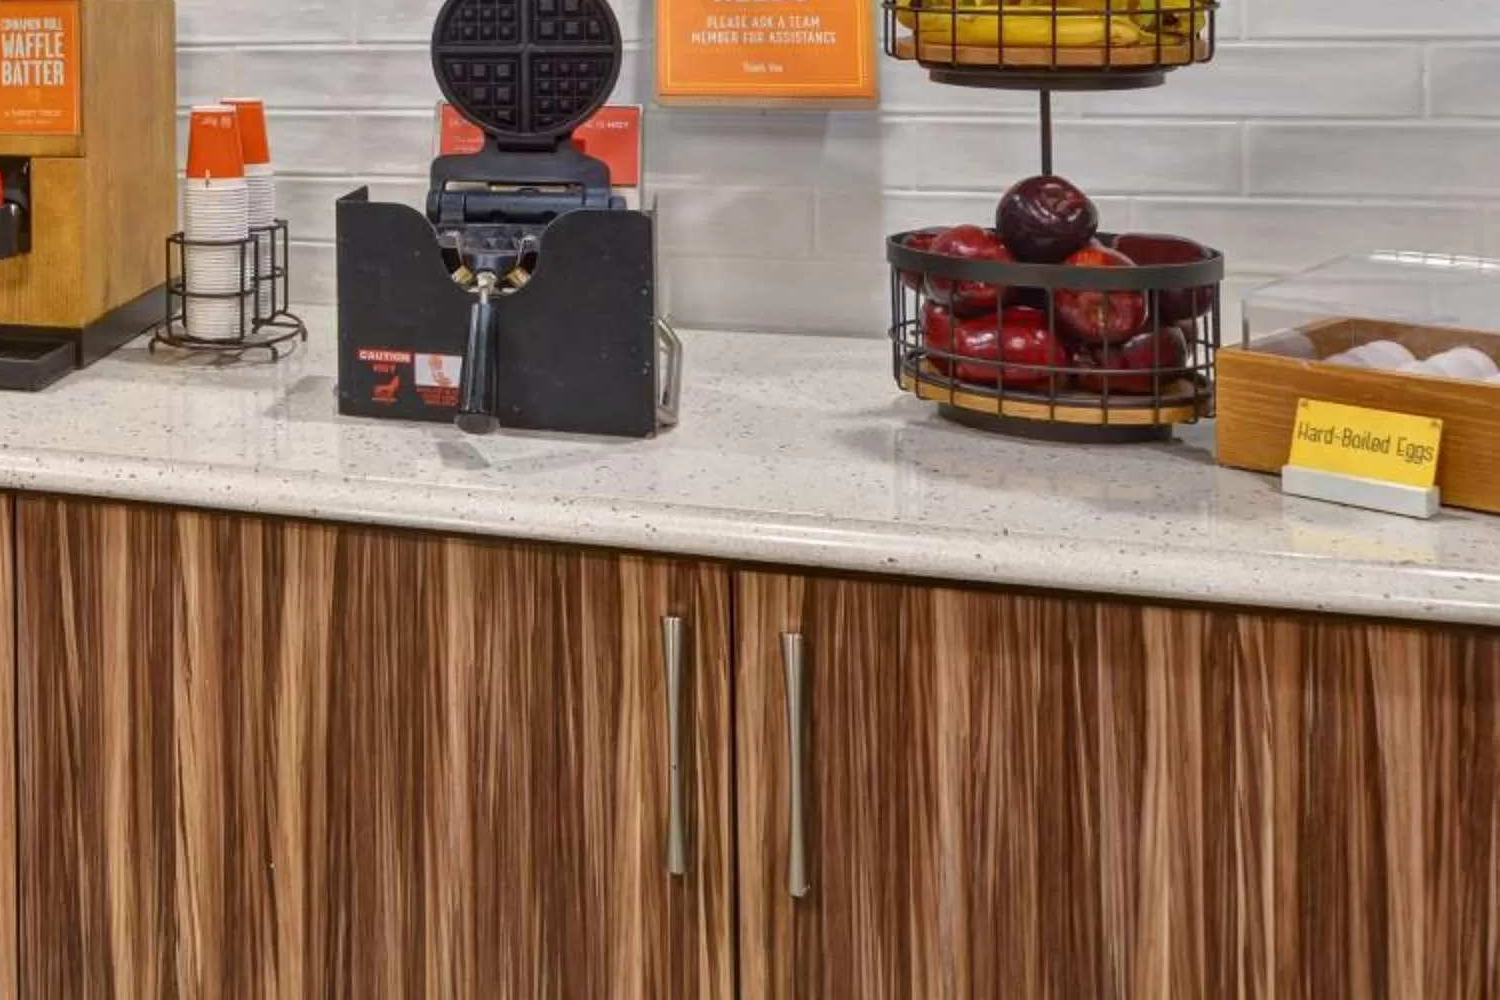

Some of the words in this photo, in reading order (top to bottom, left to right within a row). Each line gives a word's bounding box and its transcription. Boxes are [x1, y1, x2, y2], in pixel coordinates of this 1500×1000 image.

[707, 15, 748, 29] PLEASE
[751, 15, 773, 28] ASK
[777, 15, 785, 28] A
[789, 15, 820, 28] TEAM
[2, 31, 65, 59] WAFFLE
[691, 31, 738, 44] MEMBER
[743, 31, 764, 44] FOR
[768, 31, 837, 45] ASSISTANCE
[1, 59, 65, 87] BATTER
[359, 350, 411, 362] CAUTION
[1298, 421, 1391, 455] Hard-Boiled
[1396, 436, 1435, 465] Eggs
